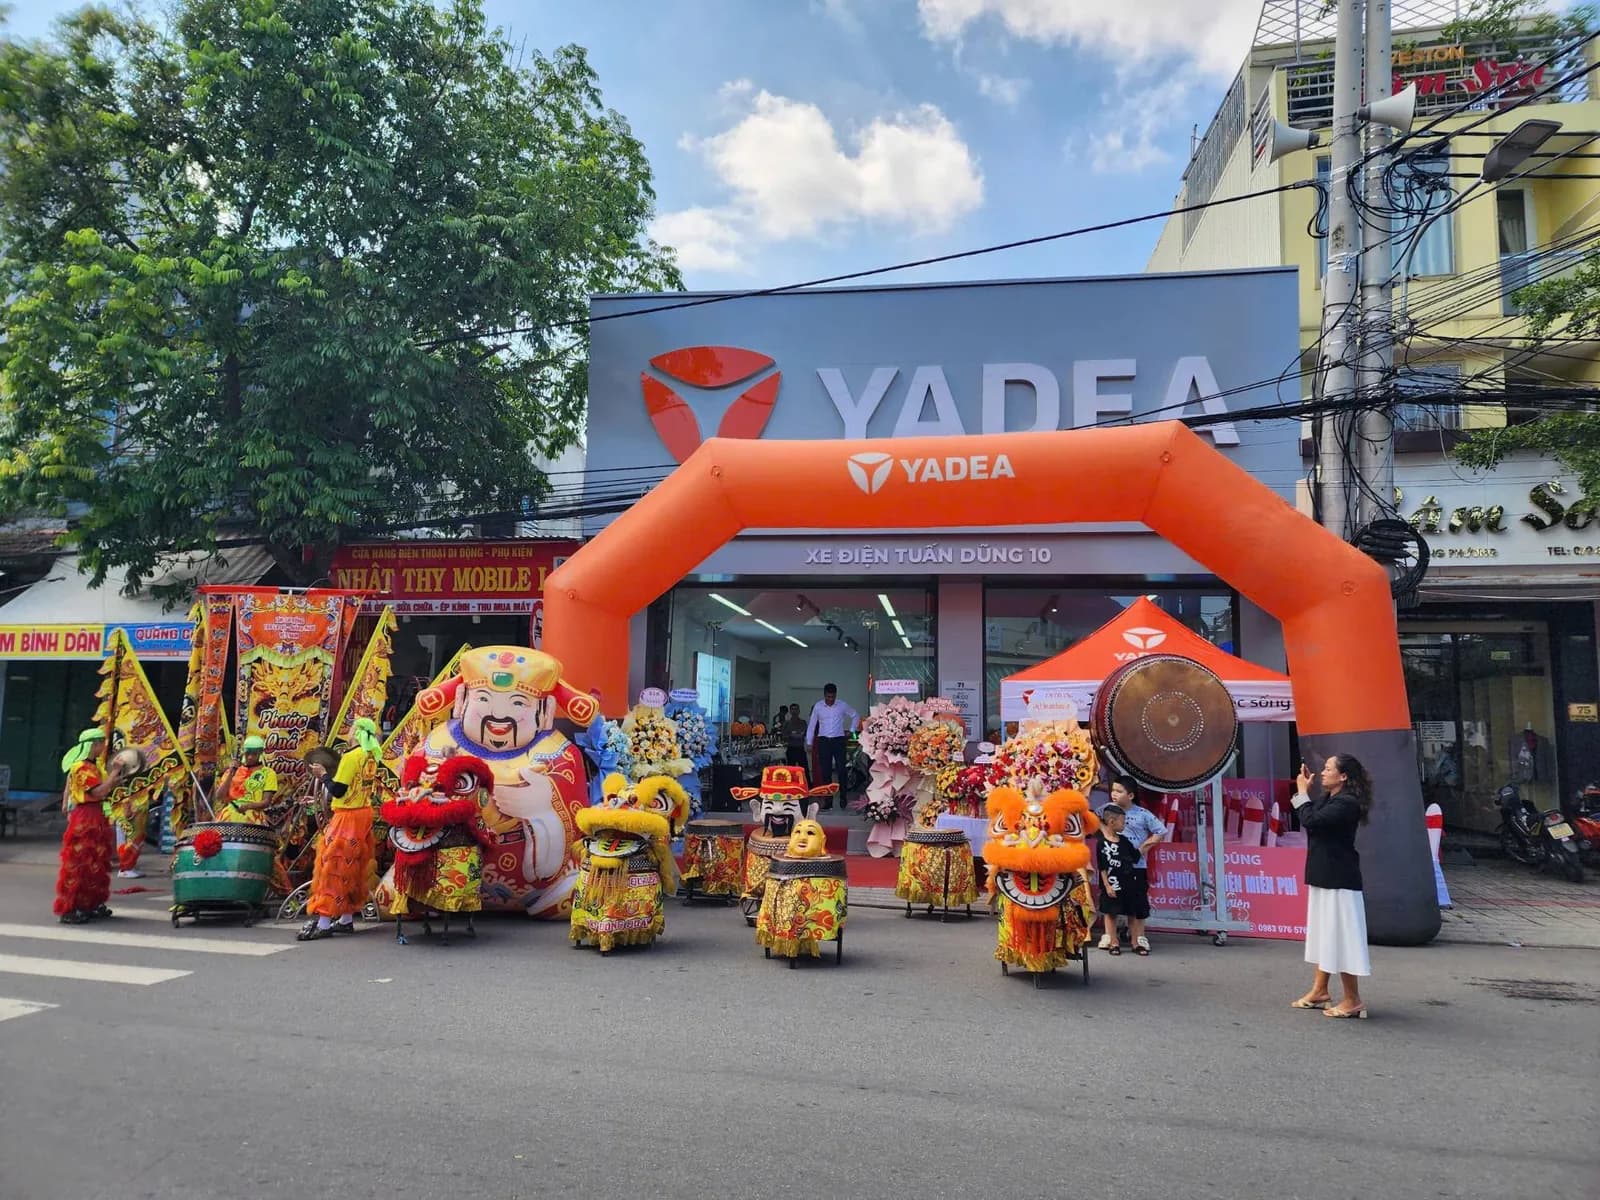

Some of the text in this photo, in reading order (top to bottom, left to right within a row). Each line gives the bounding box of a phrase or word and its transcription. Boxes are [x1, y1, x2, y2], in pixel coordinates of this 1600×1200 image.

[816, 355, 1240, 446] YADEA
[900, 454, 1016, 483] YADEA
[491, 547, 510, 560] PHỤ
[804, 542, 1052, 568] XE ĐIỆN TUẤN DŨNG 10
[336, 562, 396, 597] NHẬT
[402, 567, 447, 593] THY
[452, 566, 532, 593] MOBILE
[21, 628, 59, 652] BÌNH
[64, 628, 101, 652] DÂN
[1250, 695, 1291, 711] sống
[1576, 705, 1592, 715] 75
[1154, 849, 1176, 864] IỆN
[1178, 851, 1214, 864] TUN
